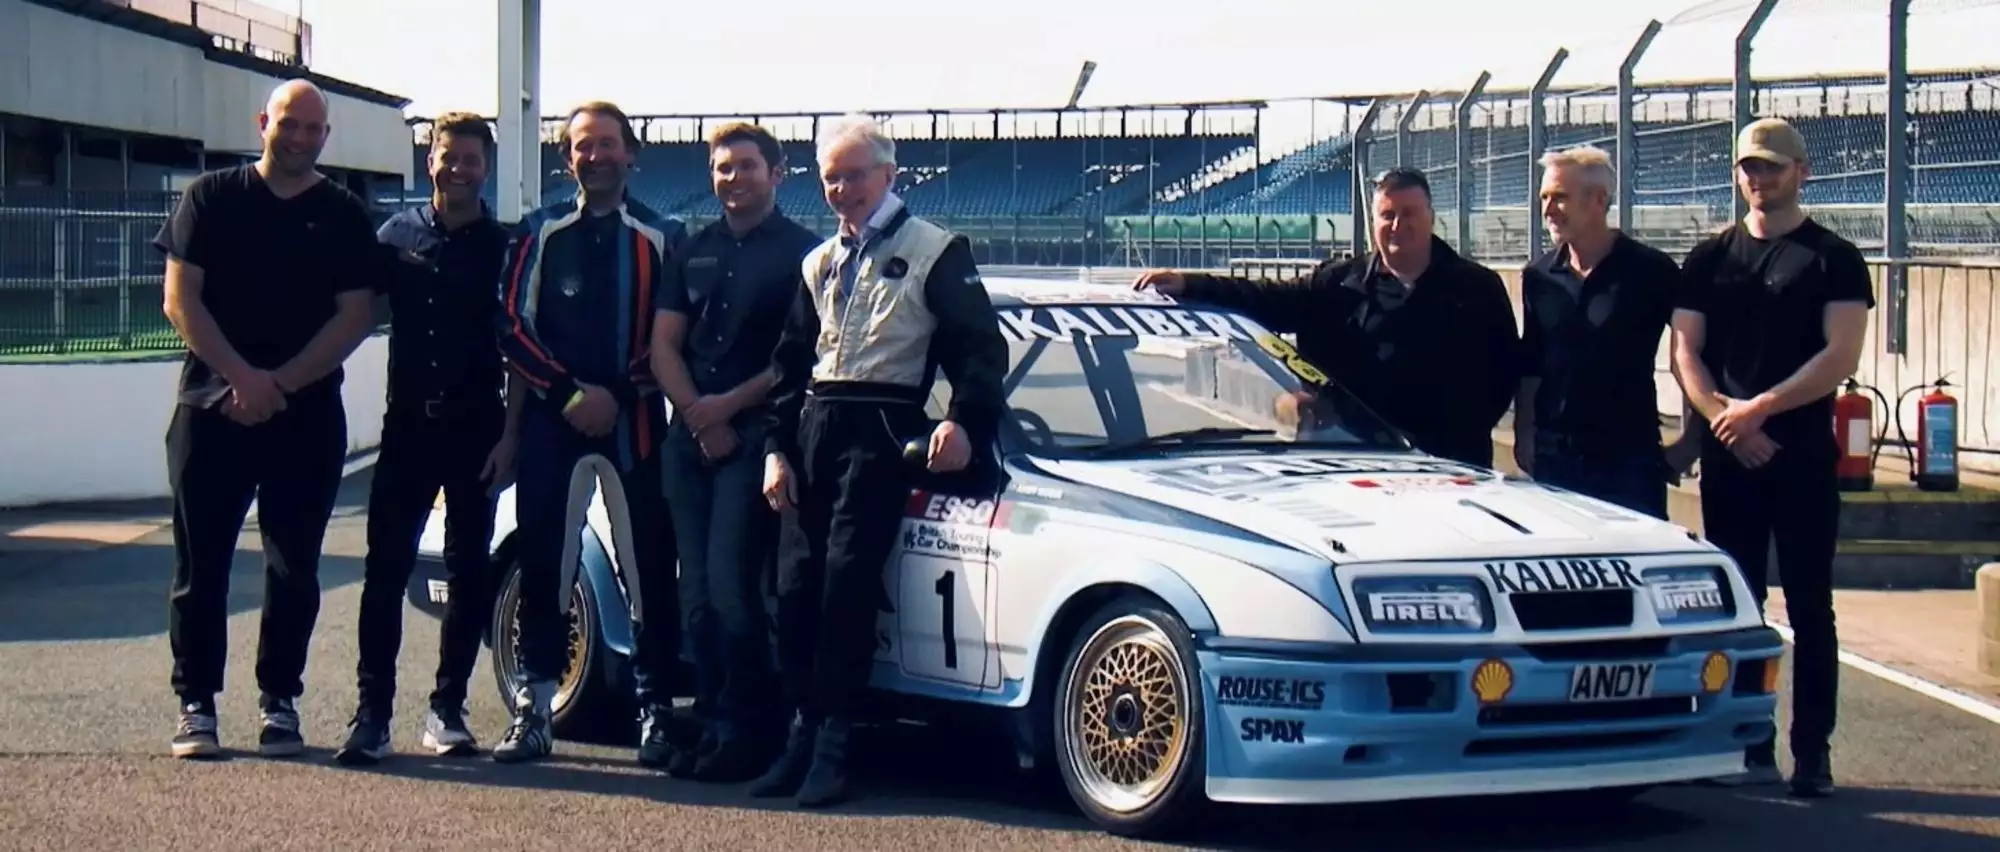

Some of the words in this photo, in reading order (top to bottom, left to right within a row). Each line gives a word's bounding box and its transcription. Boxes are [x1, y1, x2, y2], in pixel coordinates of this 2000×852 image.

[998, 306, 1251, 341] KALIBER
[924, 493, 995, 524] ESSO
[1484, 559, 1644, 593] KALIBER
[935, 570, 957, 669] 1
[1572, 663, 1653, 698] ANDY
[1241, 717, 1305, 744] SPAX
